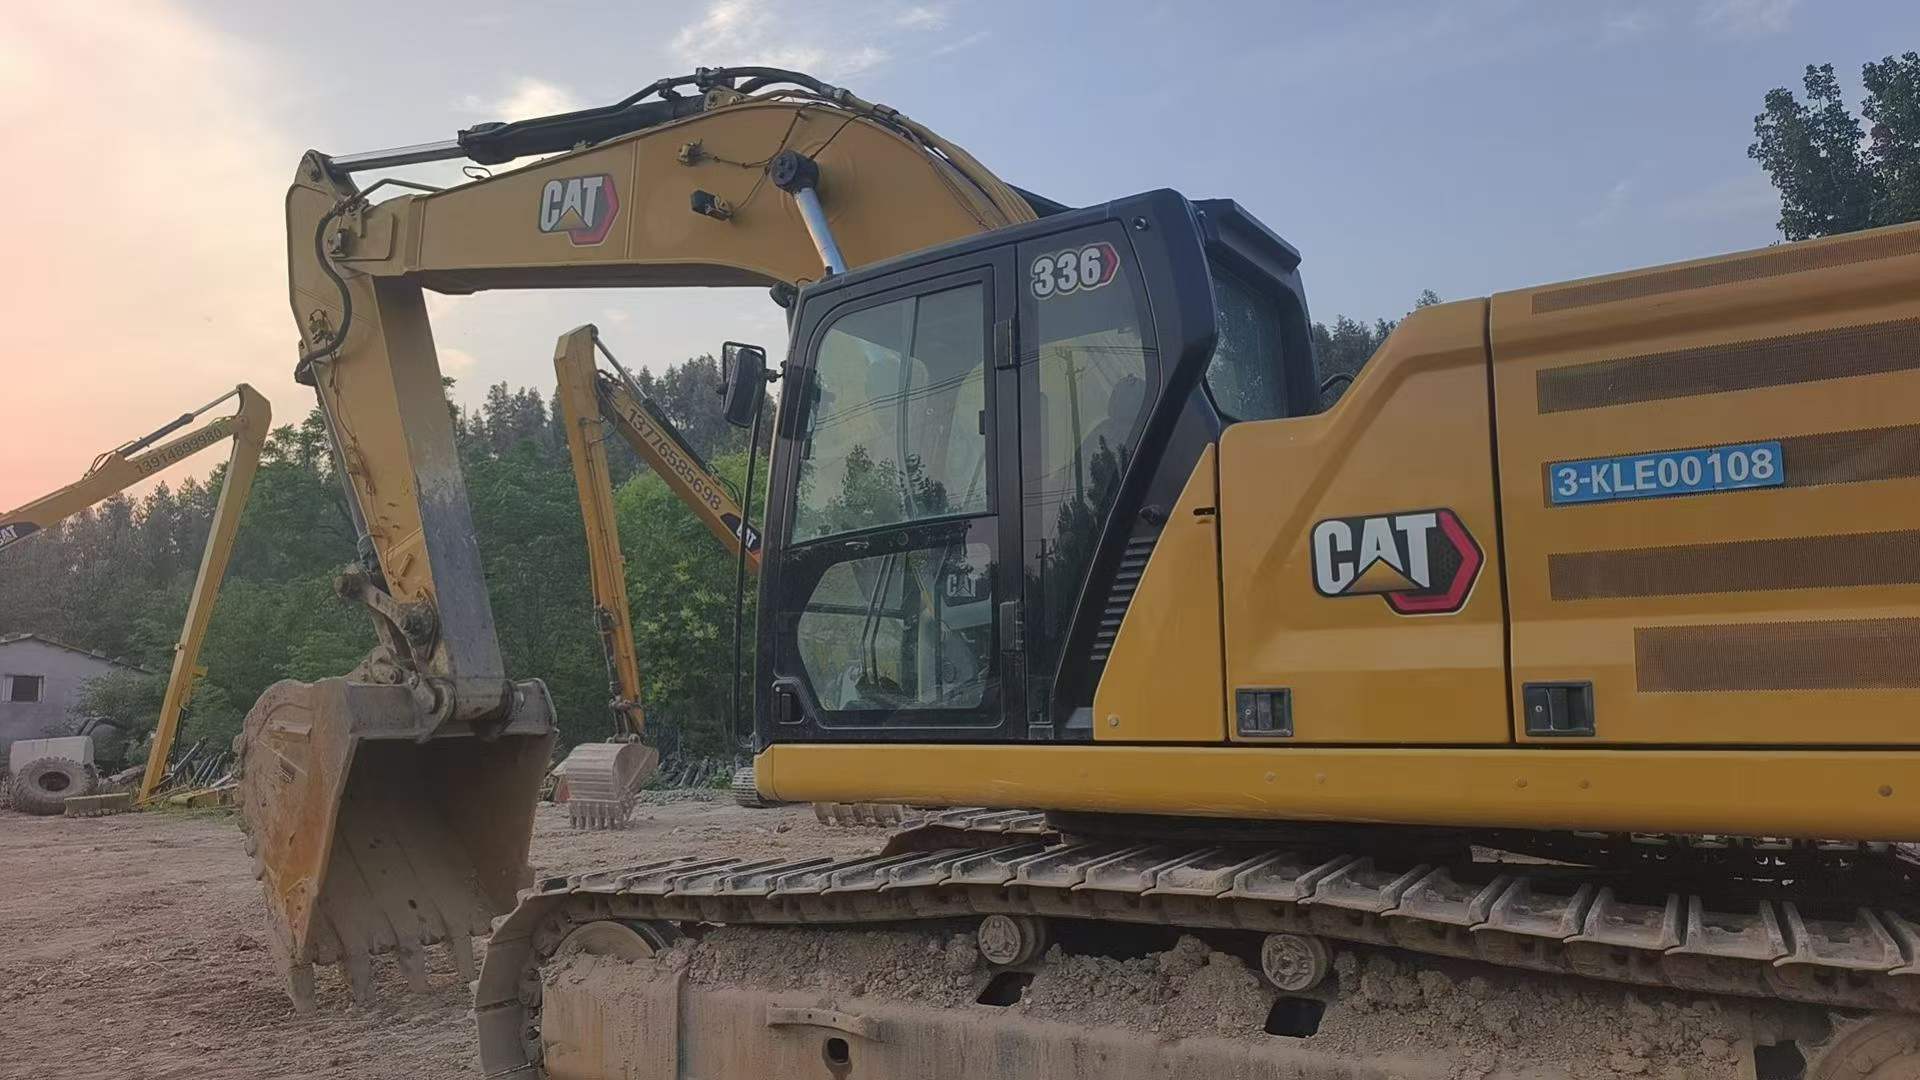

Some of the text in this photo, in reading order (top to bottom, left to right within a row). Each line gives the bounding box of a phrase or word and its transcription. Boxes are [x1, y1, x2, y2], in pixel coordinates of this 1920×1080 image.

[541, 176, 603, 232] CAT
[1033, 246, 1101, 296] 336
[628, 407, 721, 510] 13776585698
[1557, 449, 1775, 497] 3-KLE00108
[1314, 512, 1437, 595] CAT
[946, 573, 977, 598] CAT
